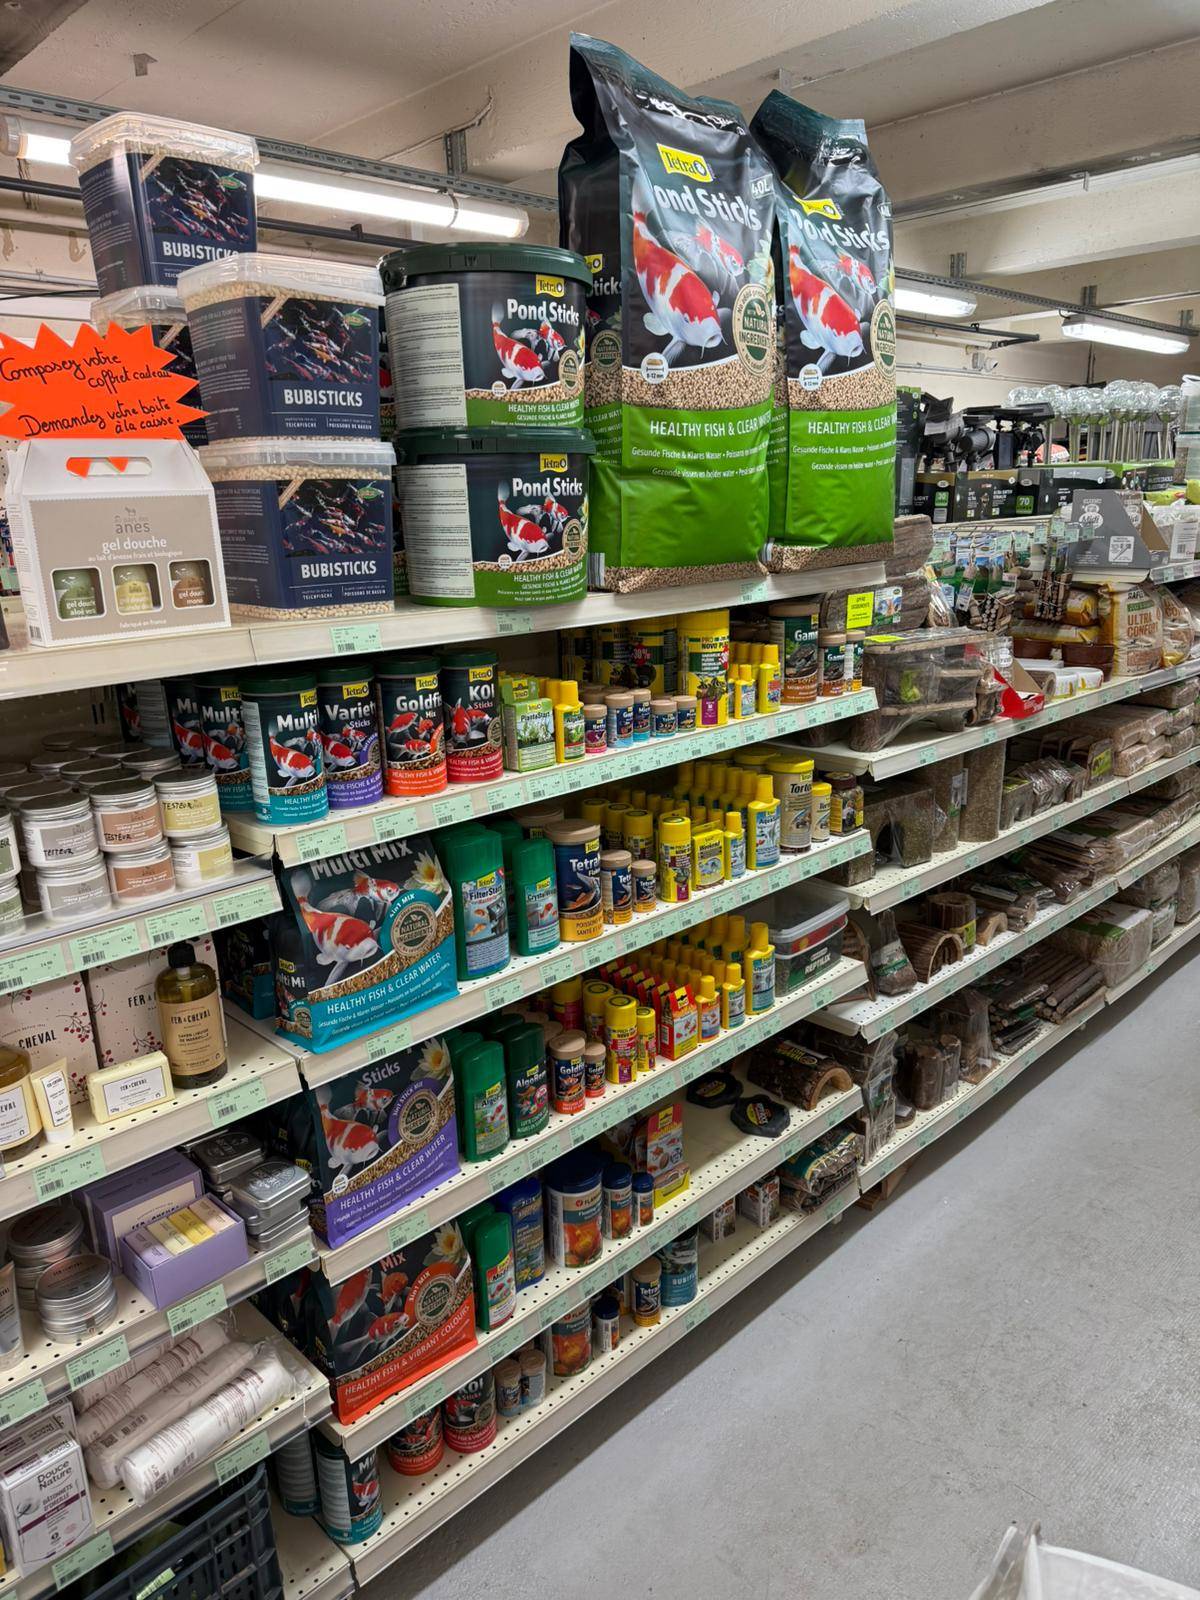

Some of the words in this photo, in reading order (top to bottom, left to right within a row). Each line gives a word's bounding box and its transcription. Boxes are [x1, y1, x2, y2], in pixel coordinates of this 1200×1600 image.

[661, 151, 696, 175] Tetra
[654, 185, 699, 214] ond
[696, 188, 762, 230] Sticks
[833, 223, 890, 251] Sticks
[538, 278, 557, 293] Tetra
[507, 299, 546, 320] Pond
[549, 302, 580, 326] Sticks
[82, 347, 121, 367] votre
[88, 367, 131, 394] coffret
[133, 365, 172, 379] cadeau
[283, 389, 363, 407] BUBISTICKS
[18, 405, 107, 437] Demandez
[107, 400, 138, 419] votre
[508, 404, 537, 413] HEALTHY
[538, 404, 551, 412] FISH
[115, 419, 123, 434] à
[125, 420, 136, 432] la
[650, 420, 701, 436] HEALTHY
[704, 423, 726, 437] FISH
[728, 422, 735, 436] &
[737, 418, 758, 434] CLEAR
[808, 421, 849, 435] HEALTHY
[852, 421, 867, 433] FISH
[867, 420, 873, 432] &
[874, 417, 891, 430] CLEAR
[632, 447, 661, 458] Gesunde
[662, 449, 681, 458] Fische
[541, 458, 559, 469] Tetra
[512, 478, 550, 497] Pond
[552, 477, 582, 496] Sticks
[102, 538, 121, 555] gel
[123, 536, 167, 550] douche
[301, 560, 377, 579] BUBISTICKS
[469, 684, 495, 701] KOI
[349, 720, 371, 730] Sticks
[163, 801, 193, 811] TESTEUR
[104, 832, 131, 842] TESTEUR
[309, 850, 372, 881] Multi
[370, 840, 413, 864] Mix
[327, 995, 366, 1014] HEALTHY
[368, 987, 387, 1002] FISH
[387, 984, 394, 993] &
[395, 971, 419, 989] CLEAR
[419, 952, 441, 974] WATER
[128, 995, 146, 1007] FER
[187, 1009, 211, 1023] CHEVAL
[19, 1029, 57, 1050] CHEVAL
[361, 1062, 401, 1088] Sticks
[340, 1188, 376, 1211] HEALTHY
[377, 1180, 394, 1193] FISH
[395, 1172, 402, 1181] &
[402, 1156, 425, 1177] CLEAR
[426, 1134, 446, 1158] WATER
[380, 1252, 407, 1273] Mix
[345, 1371, 381, 1395] HEALTHY
[382, 1363, 401, 1378] FISH
[402, 1358, 408, 1367] &
[409, 1332, 440, 1361] VIBRANT
[441, 1303, 471, 1338] COLOURS
[37, 1460, 70, 1483] Douce
[39, 1466, 72, 1491] Nature
